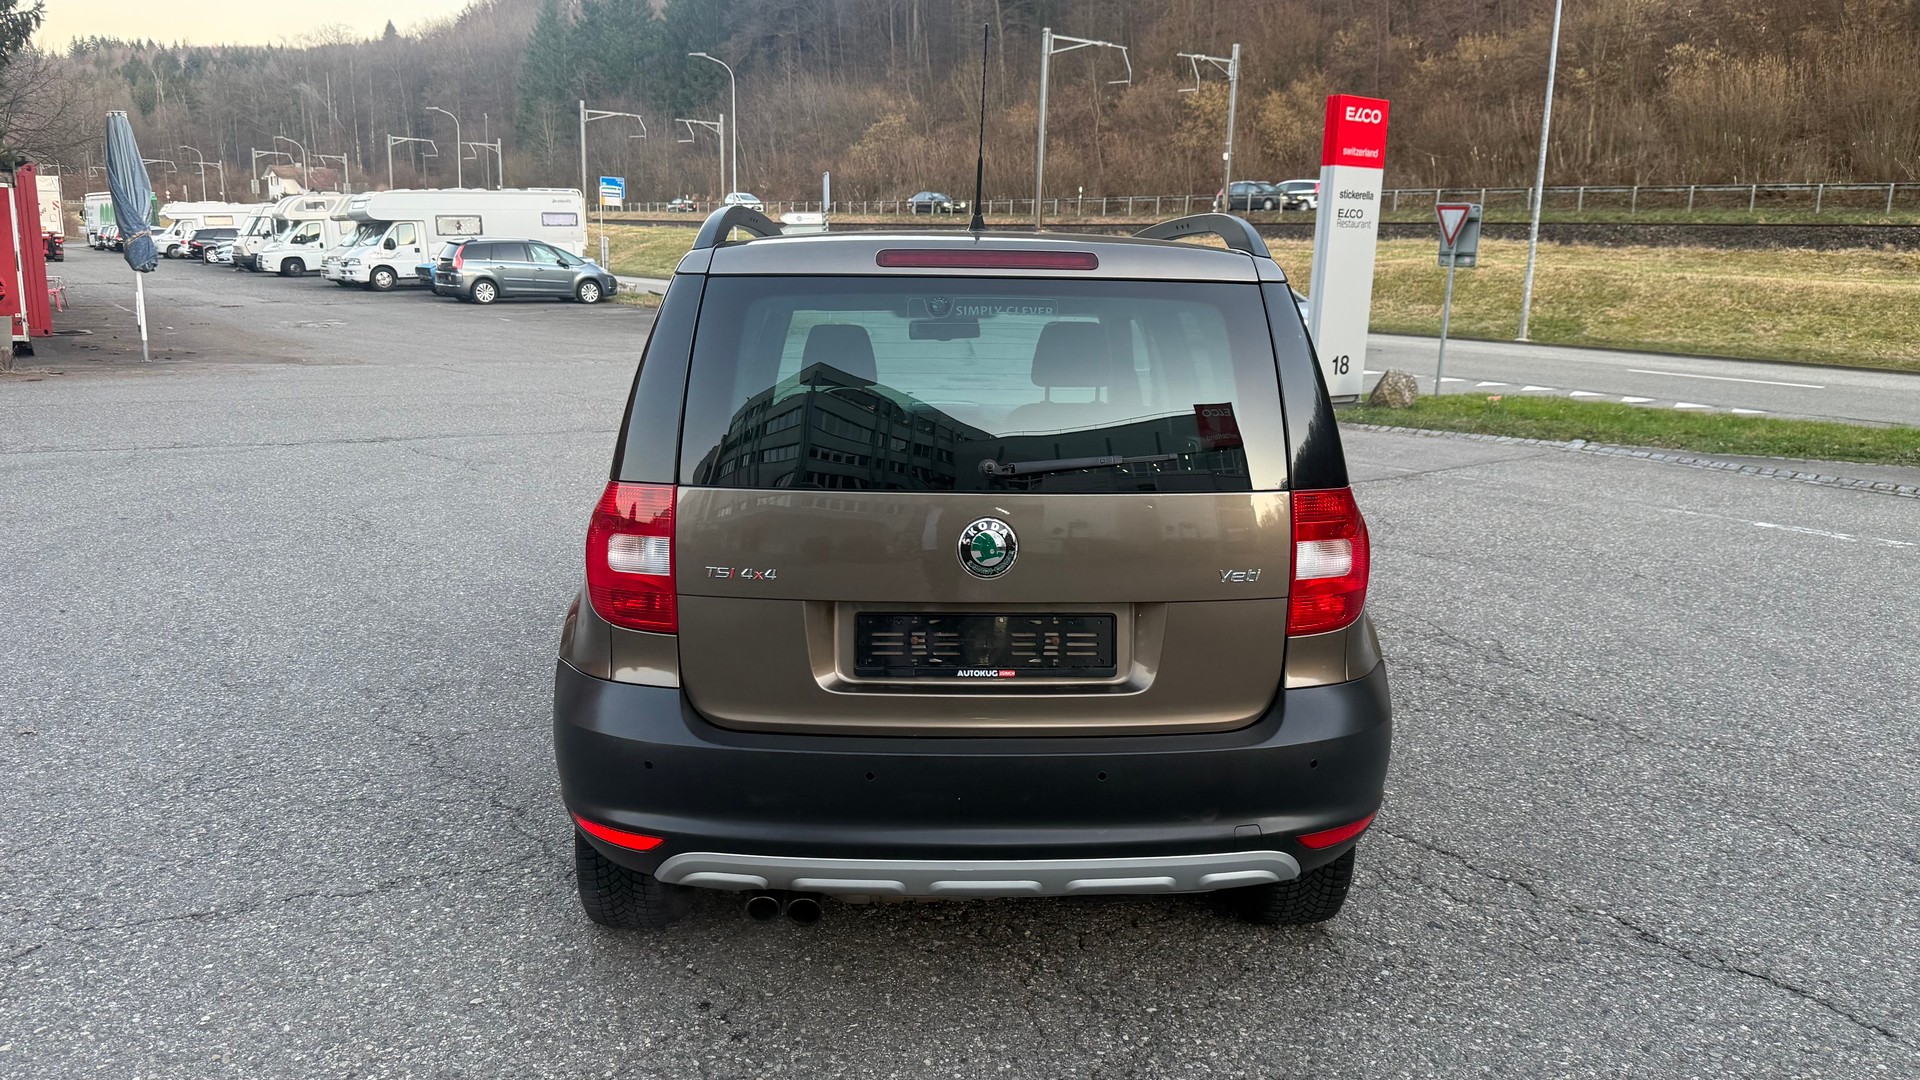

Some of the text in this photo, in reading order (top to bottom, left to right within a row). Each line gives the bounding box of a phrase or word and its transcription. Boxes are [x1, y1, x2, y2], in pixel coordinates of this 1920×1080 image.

[1345, 106, 1382, 124] ELCO
[1342, 147, 1379, 158] switzerland
[1339, 190, 1374, 200] stickerella
[1337, 208, 1364, 219] ELCO
[1336, 219, 1372, 229] Restaurant
[1332, 354, 1350, 375] 18
[741, 568, 777, 580] 4x4
[1219, 568, 1262, 582] Yeti
[957, 669, 998, 677] AUTOKUG
